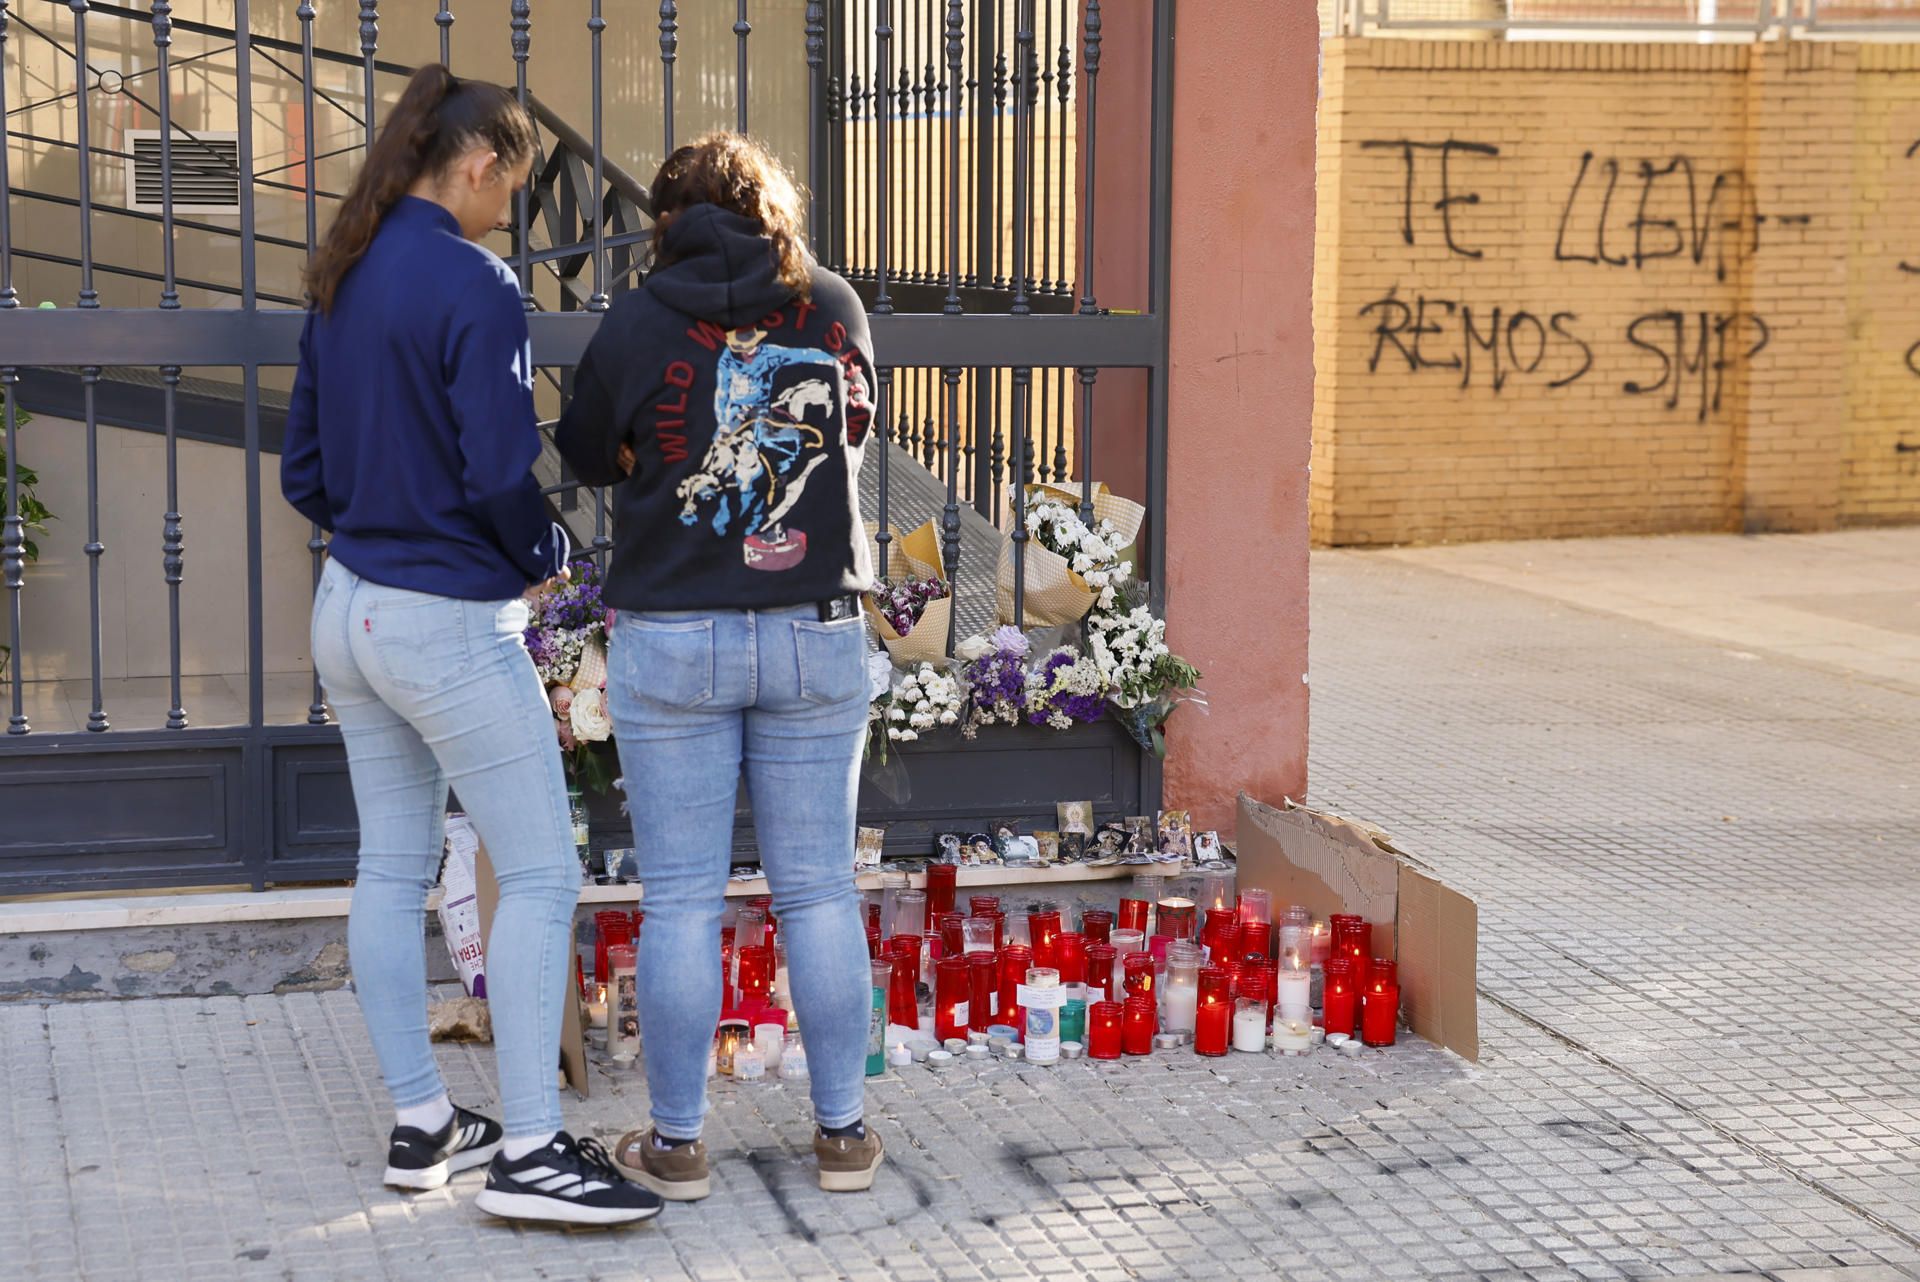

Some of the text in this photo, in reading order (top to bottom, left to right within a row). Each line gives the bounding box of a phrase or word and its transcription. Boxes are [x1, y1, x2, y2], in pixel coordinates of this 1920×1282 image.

[1360, 139, 1499, 259] TE
[656, 360, 695, 464] WILD
[686, 302, 816, 351] WST
[1358, 284, 1594, 393] REMOS
